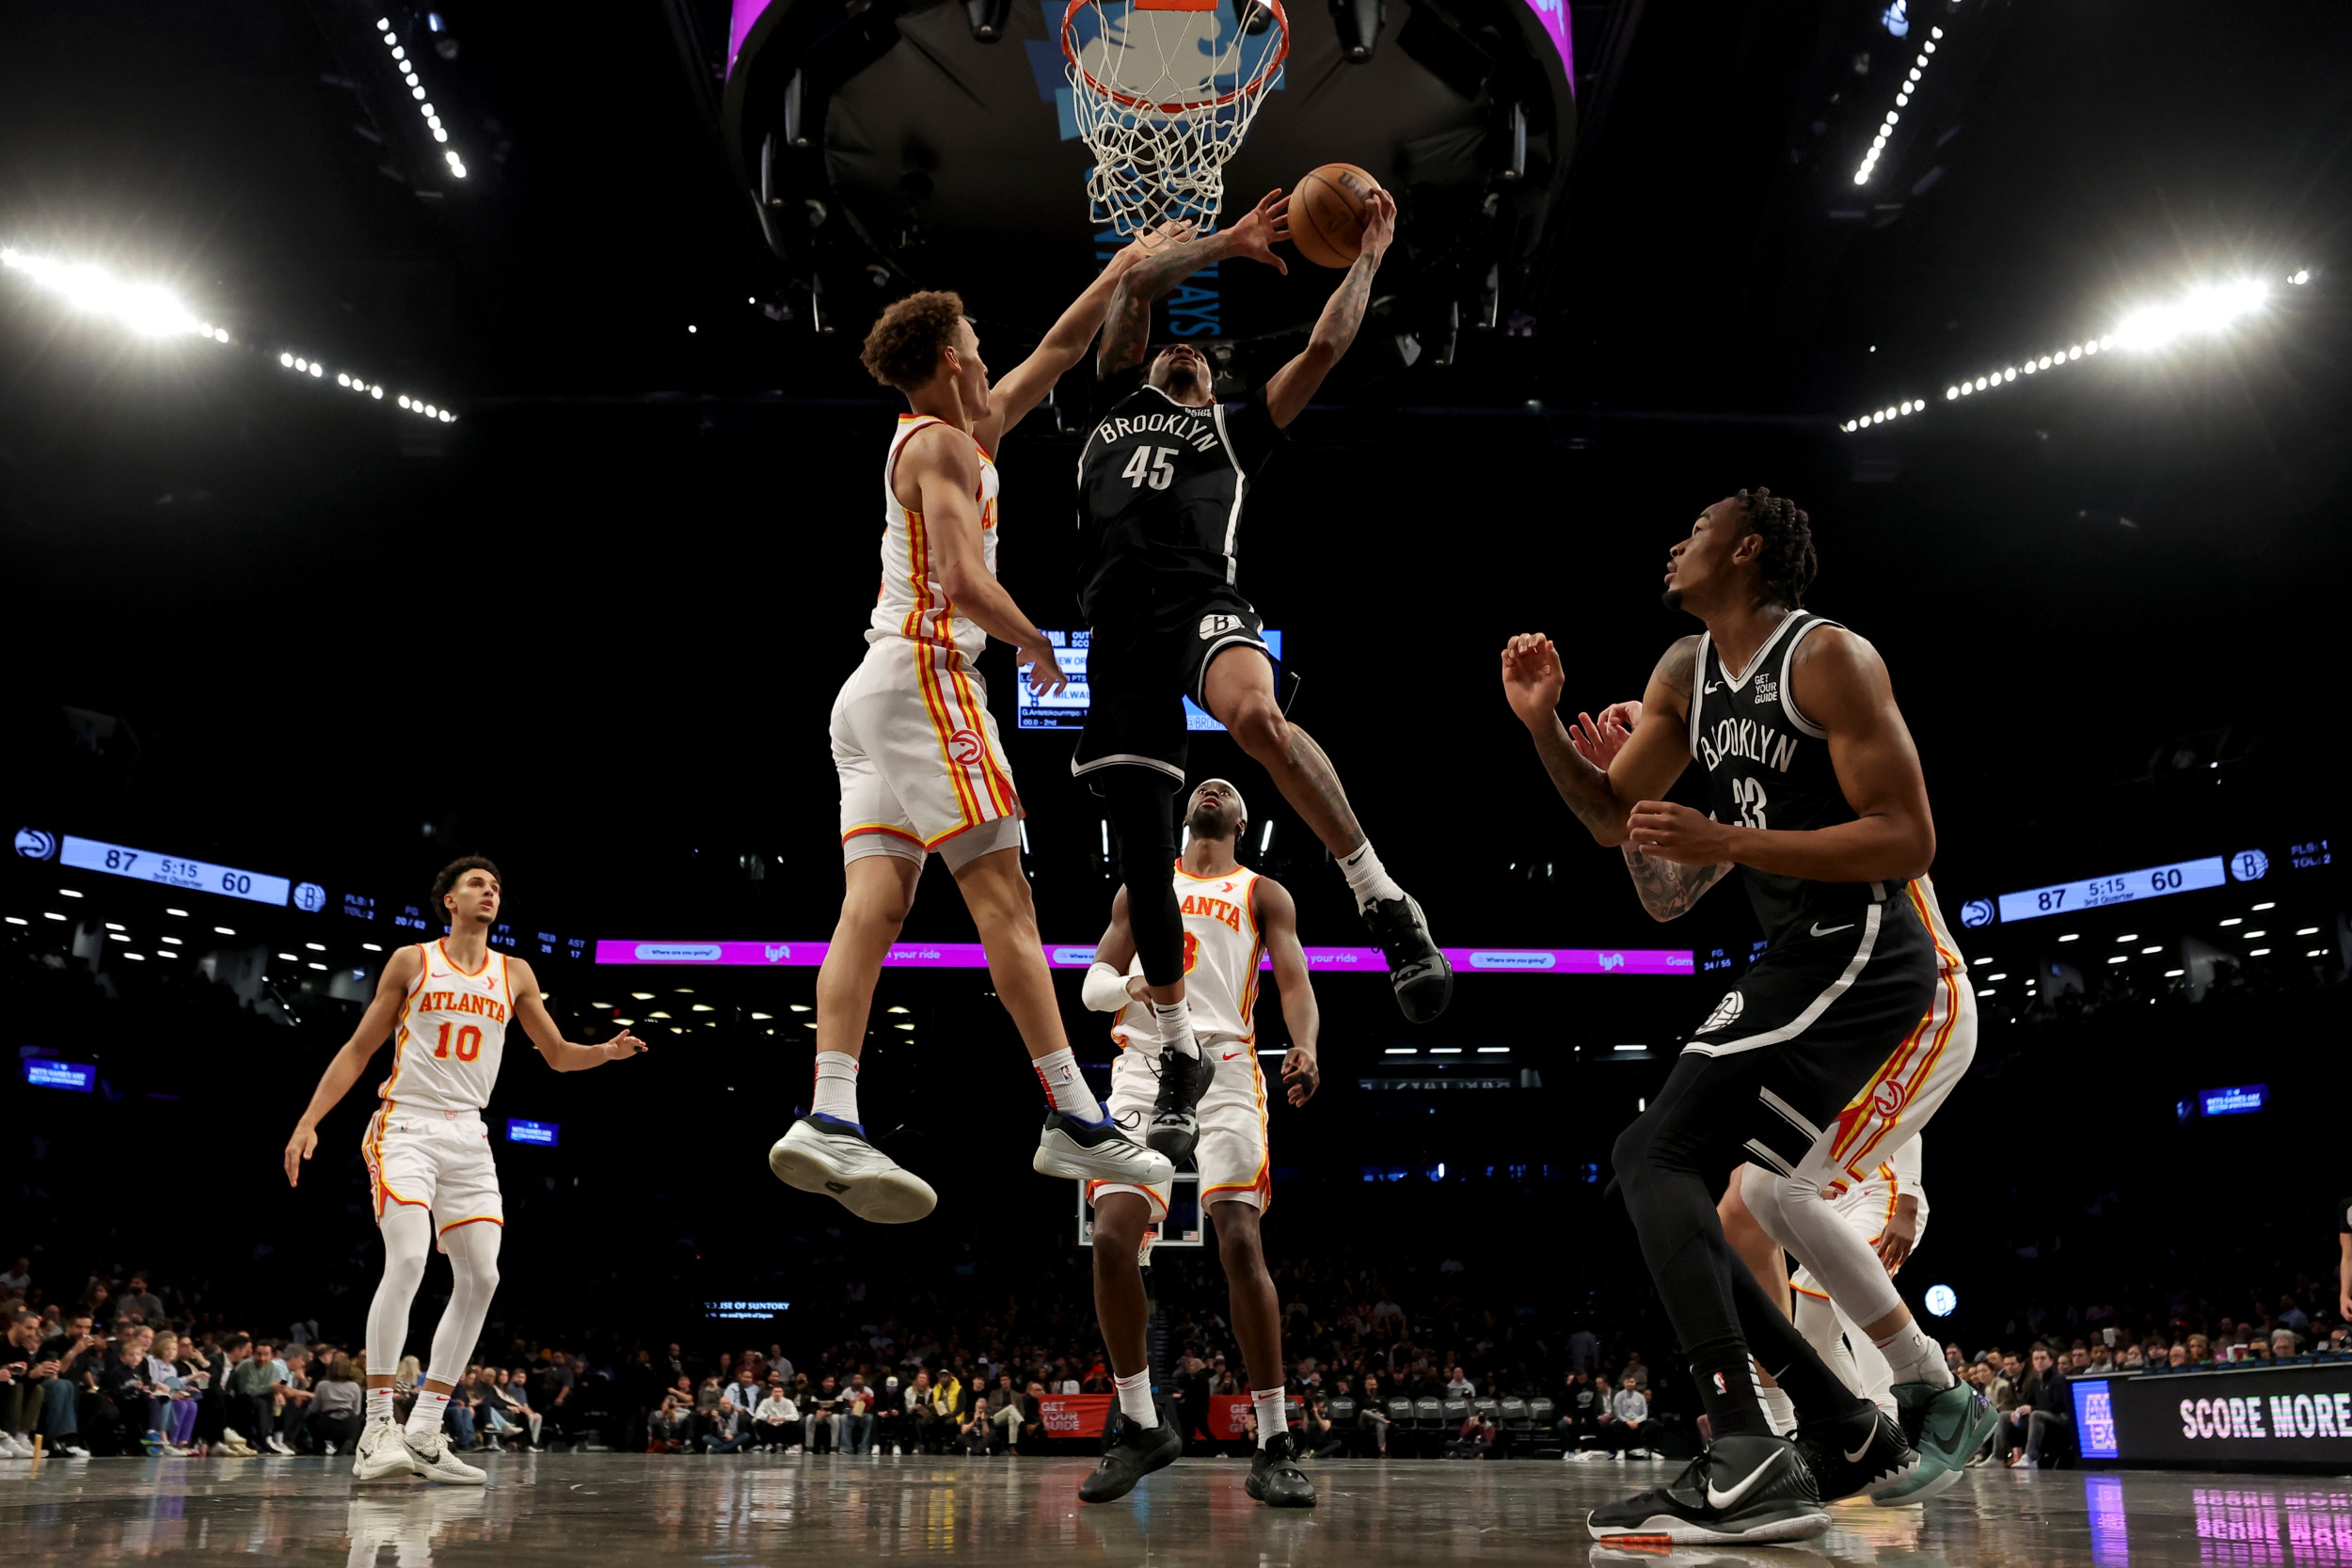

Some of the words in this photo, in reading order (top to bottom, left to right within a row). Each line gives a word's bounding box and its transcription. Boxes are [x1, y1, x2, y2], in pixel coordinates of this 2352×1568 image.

[1099, 413, 1219, 453] BROOKLYN
[1121, 445, 1180, 490] 45
[1754, 673, 1770, 686] GET
[1755, 682, 1777, 694] YOUR
[1755, 691, 1778, 705] GUIDE
[1700, 718, 1798, 773] BROOKLYN
[1732, 777, 1767, 830] 33
[105, 849, 138, 871] 87
[2322, 852, 2331, 864] 2
[161, 859, 198, 879] 5:15
[222, 872, 251, 894] 60
[2089, 878, 2125, 896] 5:15
[2152, 869, 2182, 891] 60
[2038, 889, 2066, 911] 87
[1180, 895, 1241, 933] ANTA
[498, 923, 511, 934] FT
[537, 931, 557, 943] REB
[566, 938, 585, 950] AST
[570, 950, 581, 959] 17
[764, 945, 791, 962] lyft
[893, 950, 916, 961] your
[918, 949, 941, 959] ride
[1311, 955, 1334, 964] your
[1335, 954, 1358, 963] ride
[1598, 953, 1625, 971] lyft
[1666, 956, 1693, 967] Gam
[419, 991, 506, 1024] ATLANTA
[434, 1022, 484, 1063] 10
[734, 1301, 746, 1309] OF
[747, 1301, 790, 1309] SUNTORY
[1041, 1402, 1066, 1411] GET
[1041, 1411, 1078, 1421] YOUR
[2179, 1397, 2267, 1439] SCORE
[2269, 1392, 2352, 1439] MORE
[1045, 1420, 1080, 1431] UIDE
